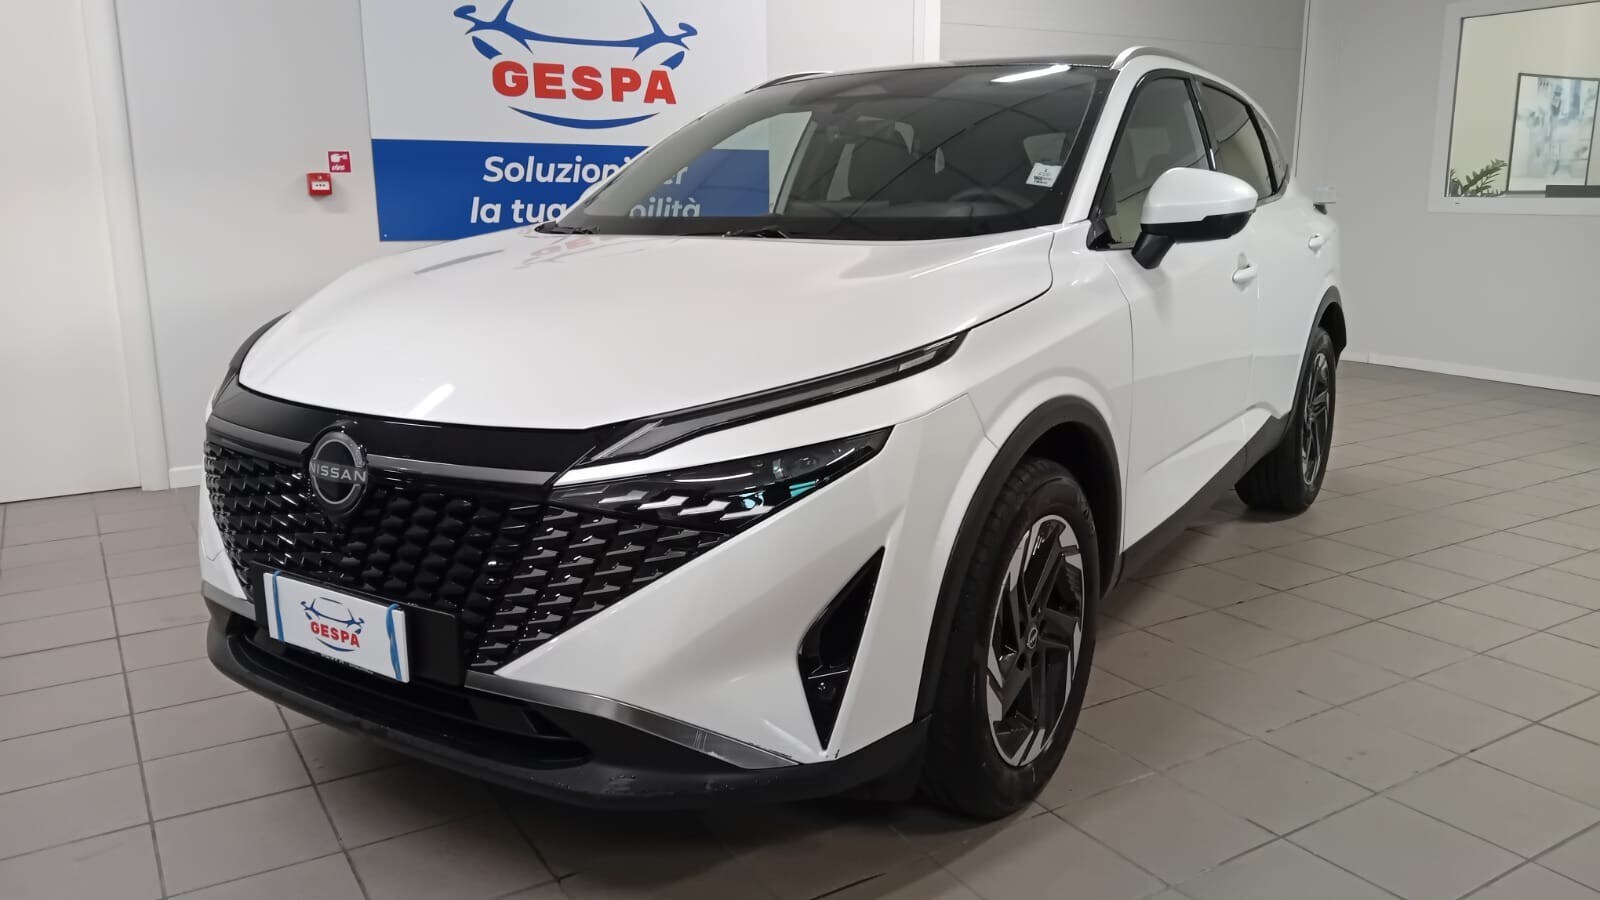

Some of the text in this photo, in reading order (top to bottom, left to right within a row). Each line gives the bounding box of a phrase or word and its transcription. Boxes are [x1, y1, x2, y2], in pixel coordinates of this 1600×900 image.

[491, 60, 677, 105] GESPA
[482, 155, 632, 184] Soluzion
[470, 196, 500, 224] la
[511, 199, 567, 223] tua
[309, 461, 367, 482] NISSAN
[310, 621, 360, 648] GESPA
